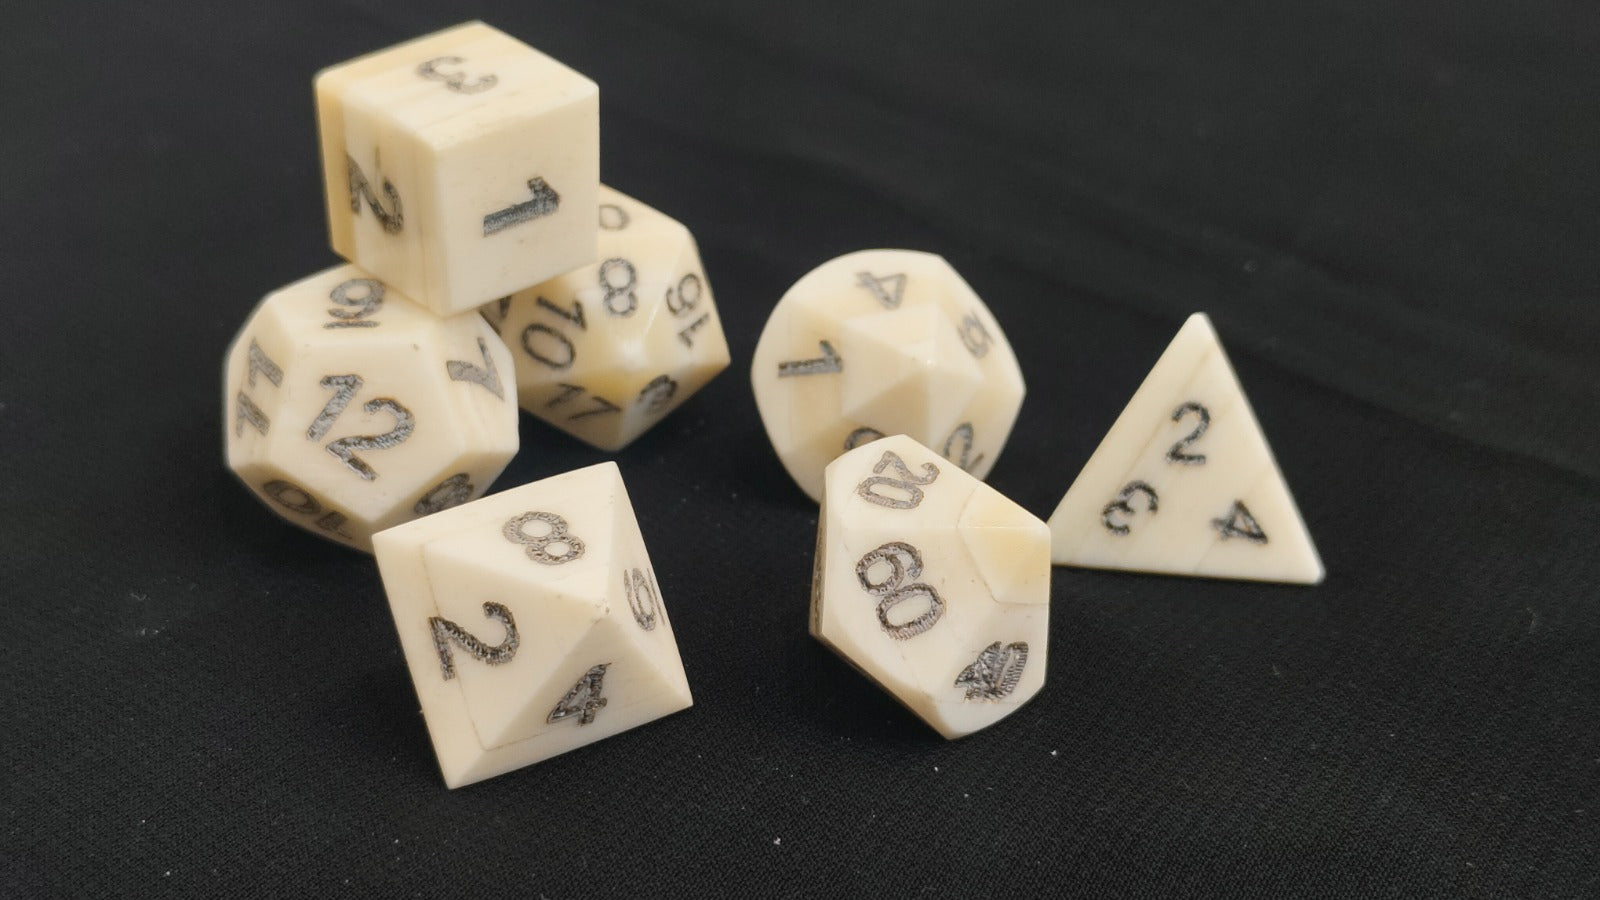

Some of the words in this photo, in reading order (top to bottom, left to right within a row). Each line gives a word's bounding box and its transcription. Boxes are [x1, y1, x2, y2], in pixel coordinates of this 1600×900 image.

[417, 56, 498, 95] 3
[346, 152, 404, 236] 2
[483, 176, 561, 238] 1
[600, 257, 638, 316] 8
[855, 271, 908, 310] 4
[520, 295, 588, 371] 10
[777, 339, 843, 378] 1
[235, 336, 285, 438] 11
[446, 336, 505, 402] 7
[305, 373, 416, 482] 12
[546, 382, 622, 421] 17
[1165, 401, 1211, 465] 2
[856, 450, 941, 510] 20
[1101, 479, 1159, 536] 3
[502, 510, 586, 566] 8
[1210, 499, 1269, 545] 4
[854, 541, 947, 642] 60
[427, 600, 521, 682] 2
[954, 640, 1030, 704] 40
[545, 662, 613, 727] 4
